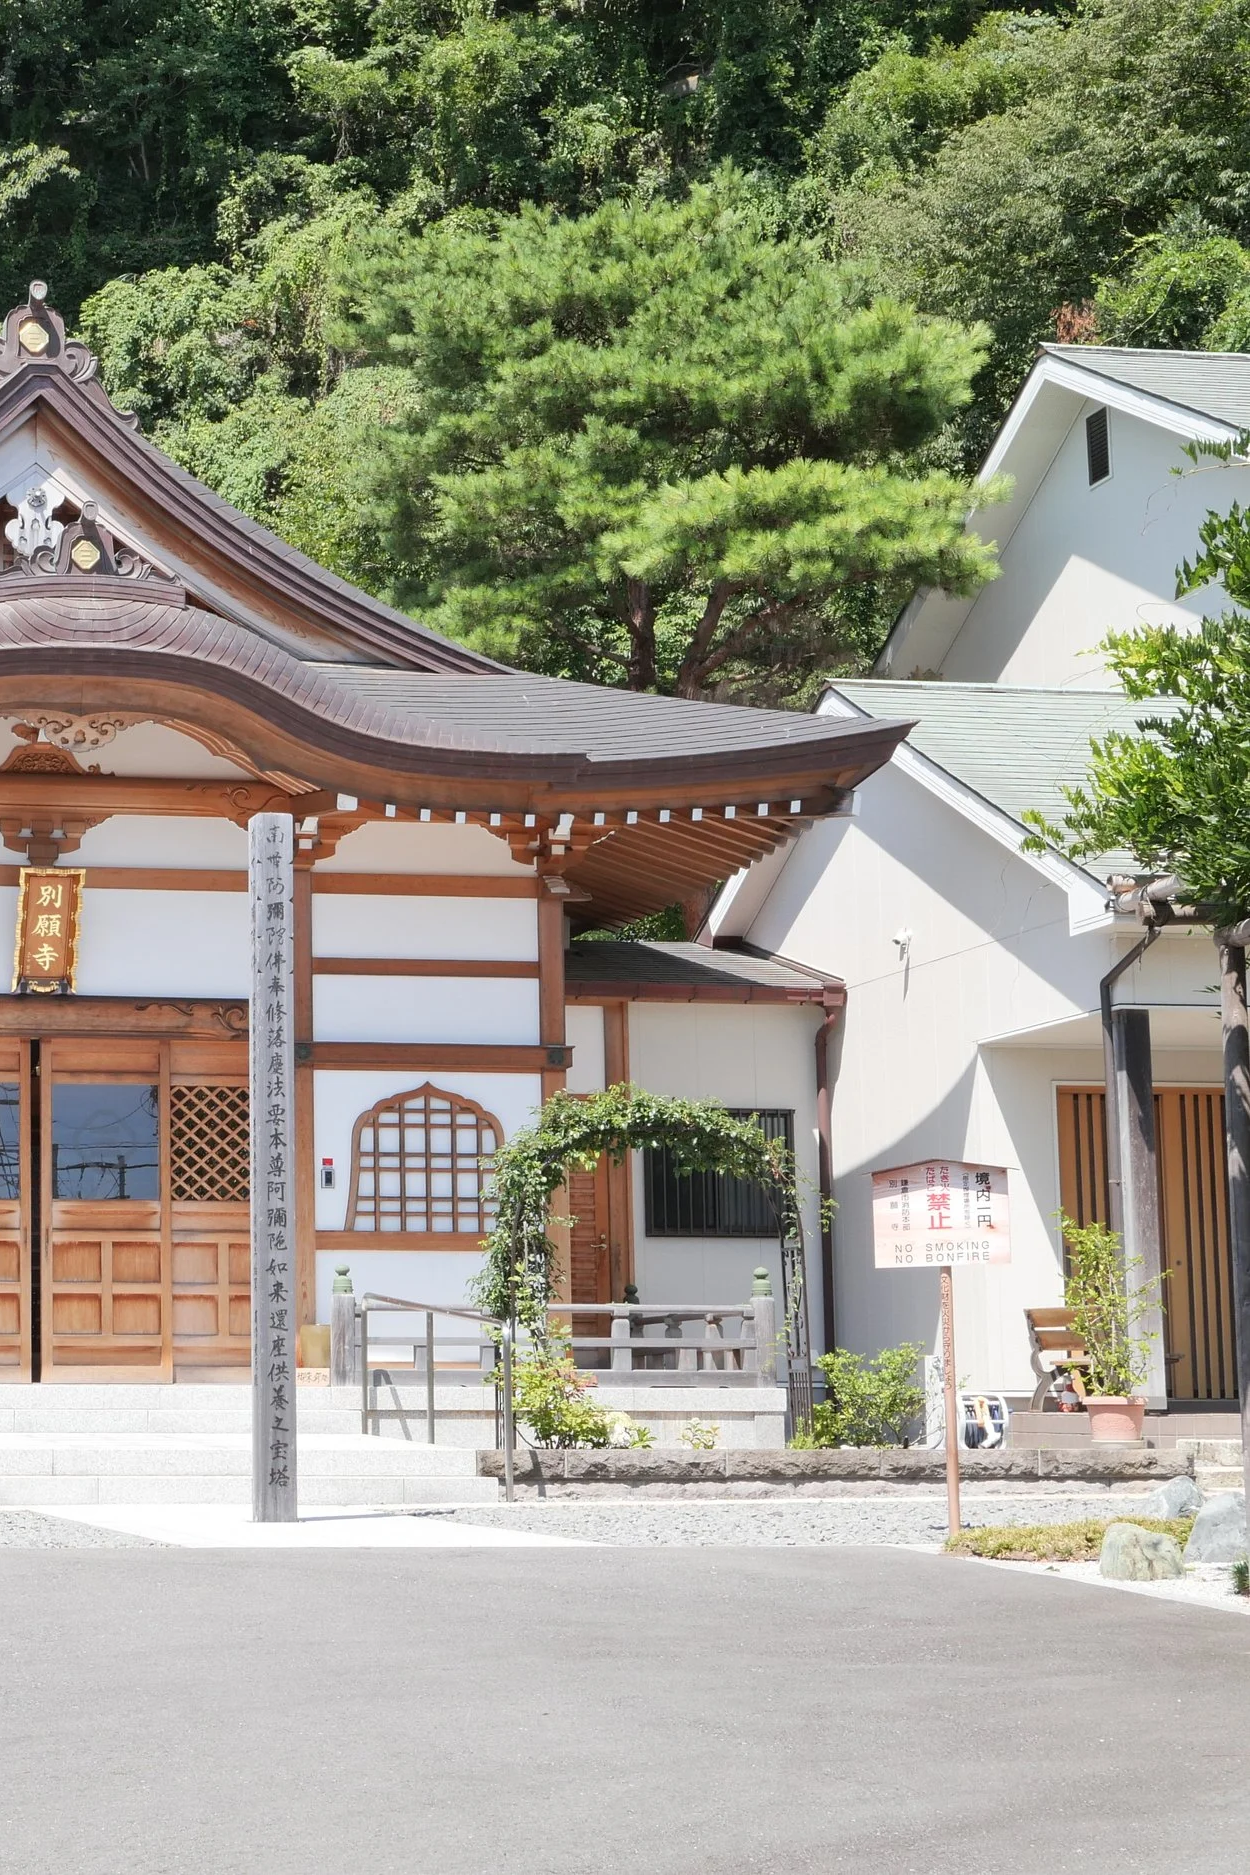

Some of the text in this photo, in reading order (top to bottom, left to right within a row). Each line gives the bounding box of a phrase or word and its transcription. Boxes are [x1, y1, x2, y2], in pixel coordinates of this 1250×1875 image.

[31, 883, 63, 971] 別願寺
[925, 1166, 937, 1191] たばこ
[939, 1166, 951, 1191] たき火
[888, 1179, 899, 1231] 別願寺
[900, 1179, 911, 1231] 鎌倉市消防本部
[926, 1193, 953, 1230] 禁止
[974, 1171, 992, 1228] 境内一円
[894, 1240, 991, 1253] NO SMOKING
[895, 1251, 991, 1264] NO BONFIRE
